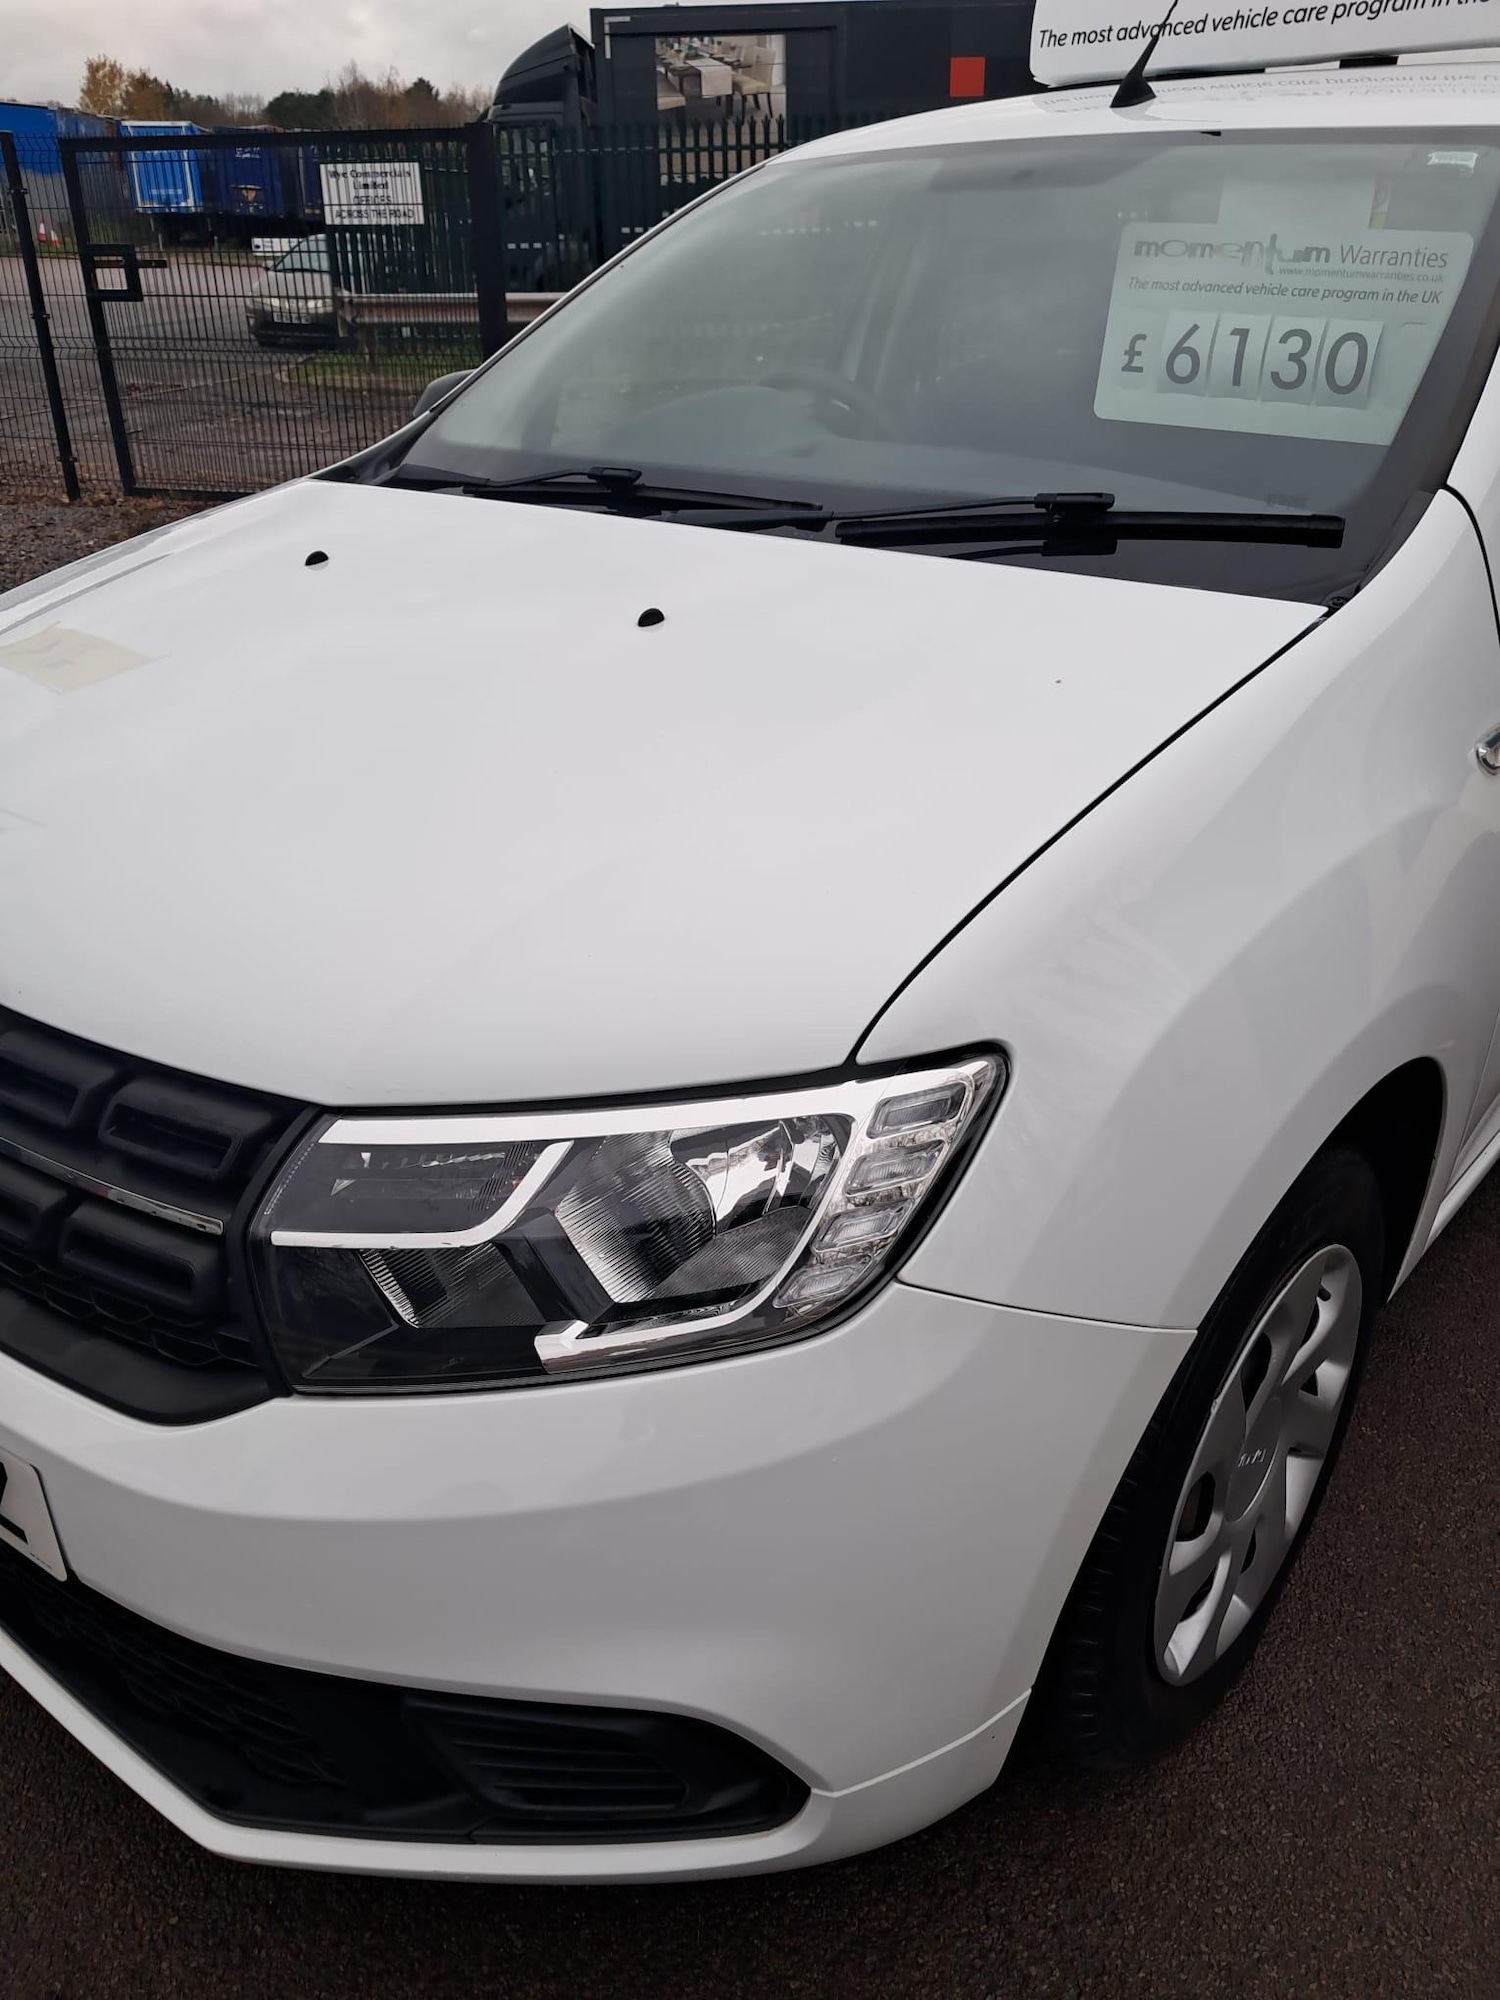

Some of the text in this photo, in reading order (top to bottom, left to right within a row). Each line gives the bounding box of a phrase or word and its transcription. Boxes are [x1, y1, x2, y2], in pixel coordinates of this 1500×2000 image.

[1039, 29, 1067, 48] The
[1071, 25, 1113, 45] most
[1116, 13, 1209, 41] advanced
[1212, 6, 1279, 32] vehicle
[1283, 4, 1328, 24] care
[1331, 0, 1426, 25] program
[1340, 244, 1449, 268] Warranties
[1128, 276, 1443, 305] The most advanced vehicle care program in the UK
[1165, 323, 1369, 396] 6130
